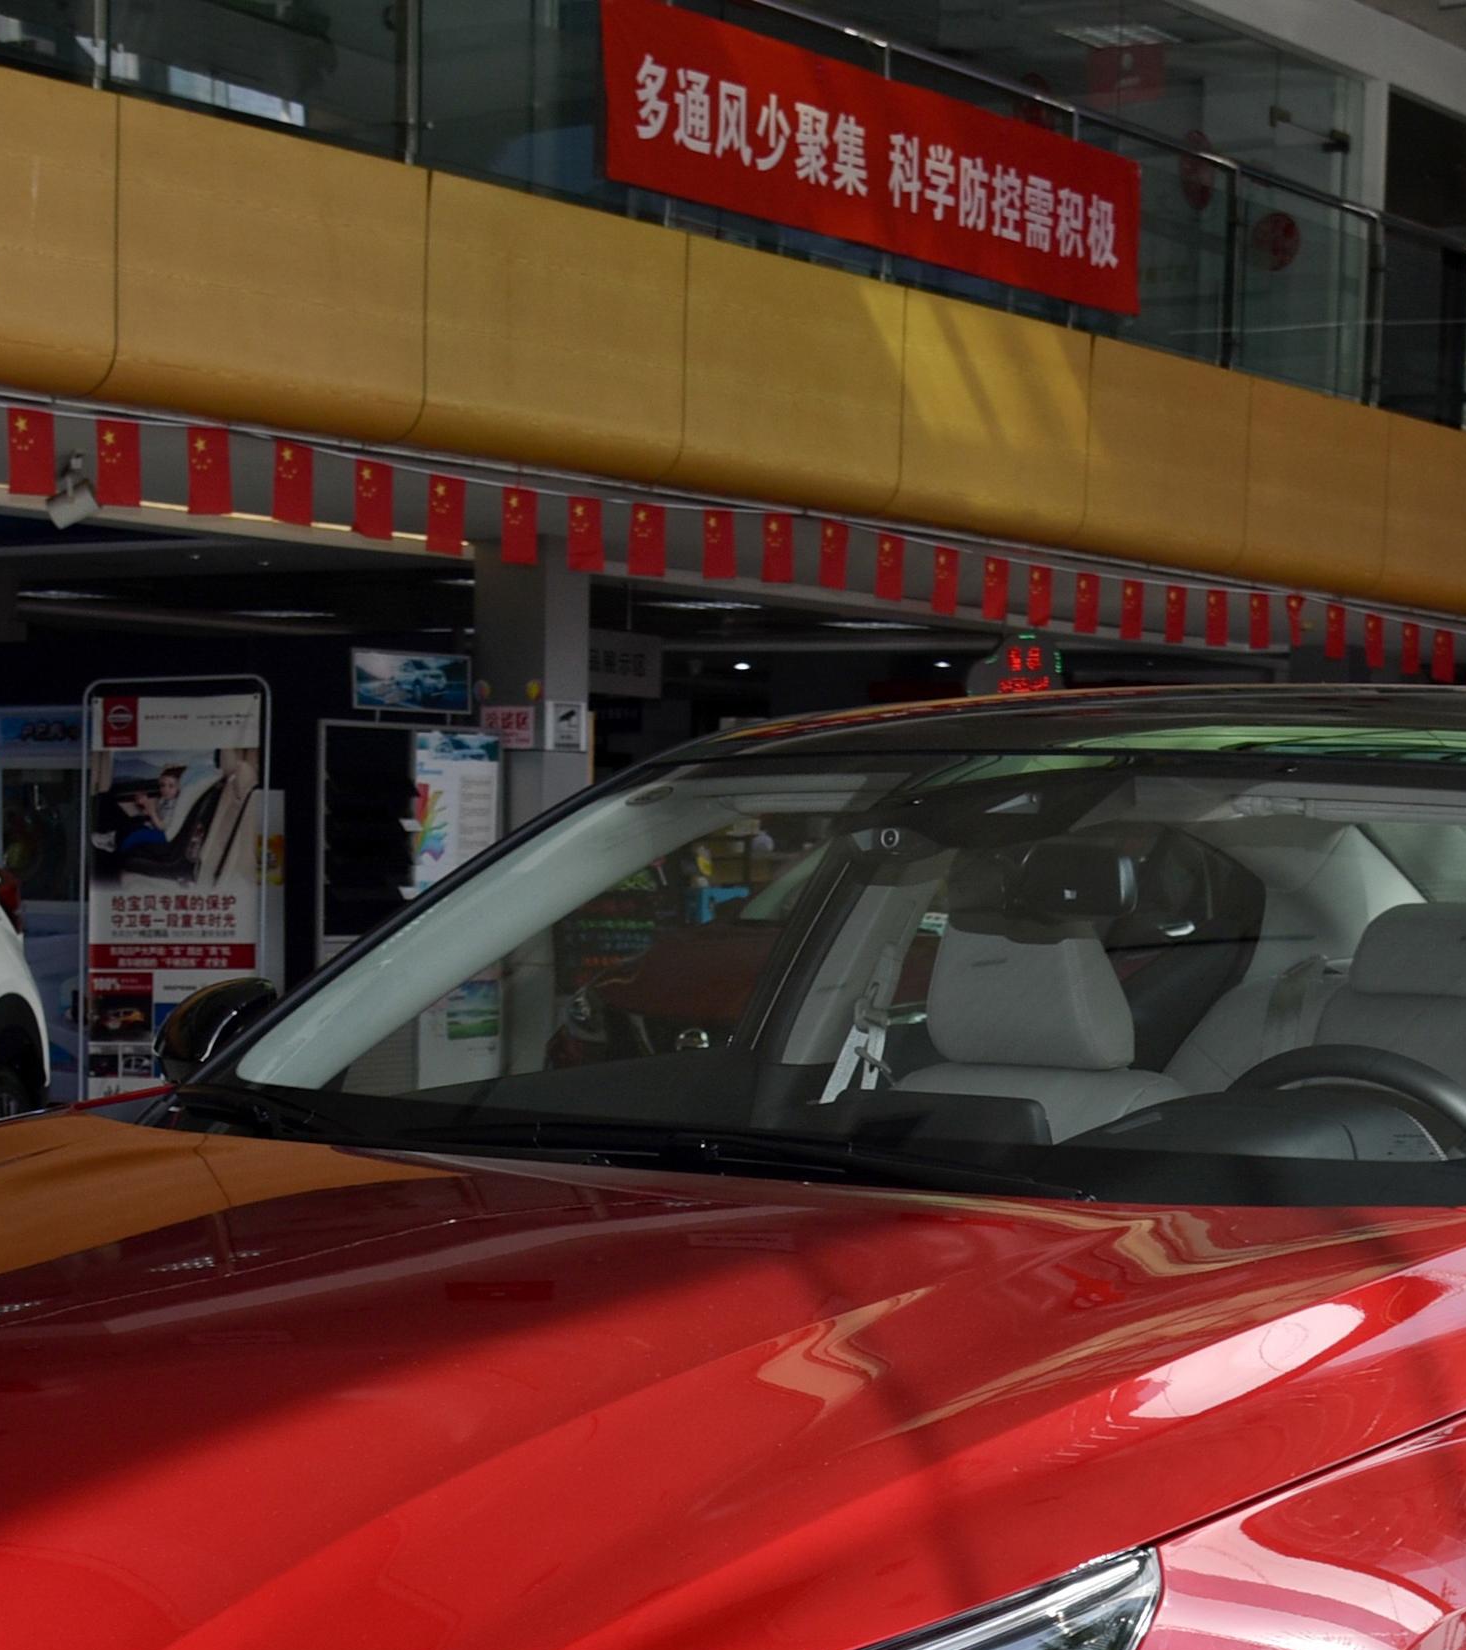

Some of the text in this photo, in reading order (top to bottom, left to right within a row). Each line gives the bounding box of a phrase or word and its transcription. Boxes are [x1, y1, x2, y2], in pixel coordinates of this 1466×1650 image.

[635, 53, 1119, 269] 多通风少聚集 科学防控需积极
[110, 894, 237, 912] 给宝贝专属的保护
[110, 913, 237, 929] 守卫每一段童年时光
